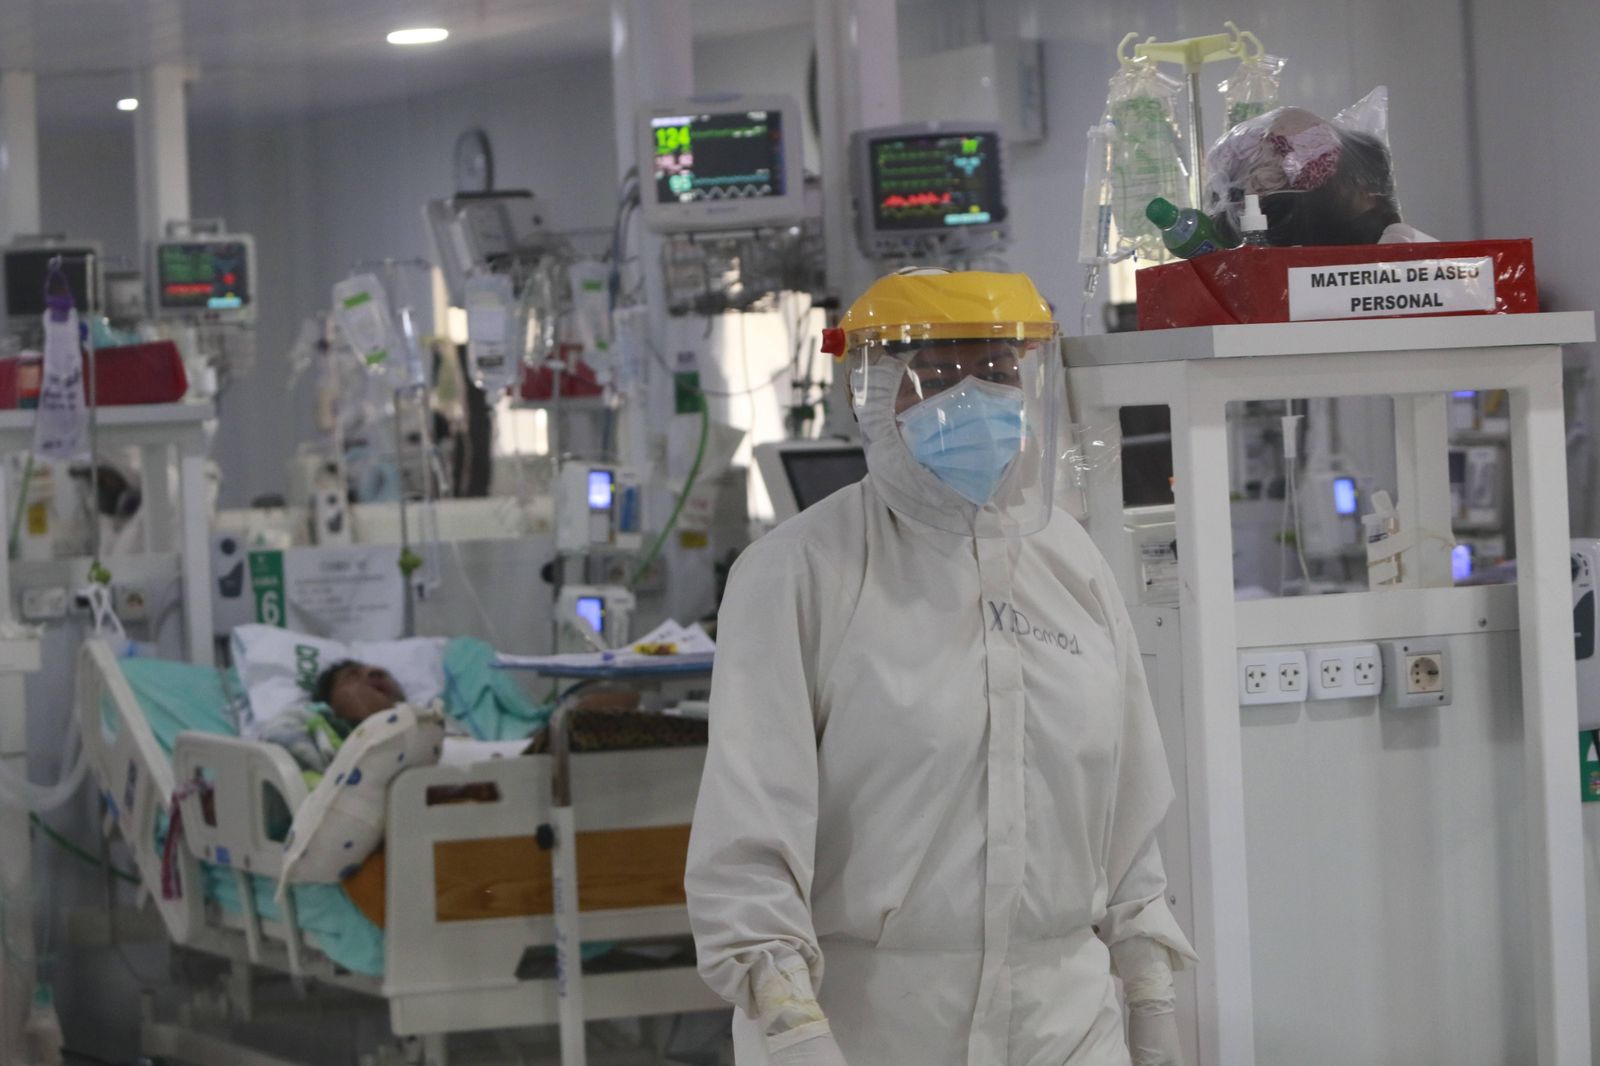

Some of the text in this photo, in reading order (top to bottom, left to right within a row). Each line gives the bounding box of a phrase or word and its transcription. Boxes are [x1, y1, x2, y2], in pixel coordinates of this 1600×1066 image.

[1311, 265, 1479, 288] MATERIAL DE ASEO
[1351, 293, 1443, 312] PERSONAL
[261, 591, 280, 625] 6
